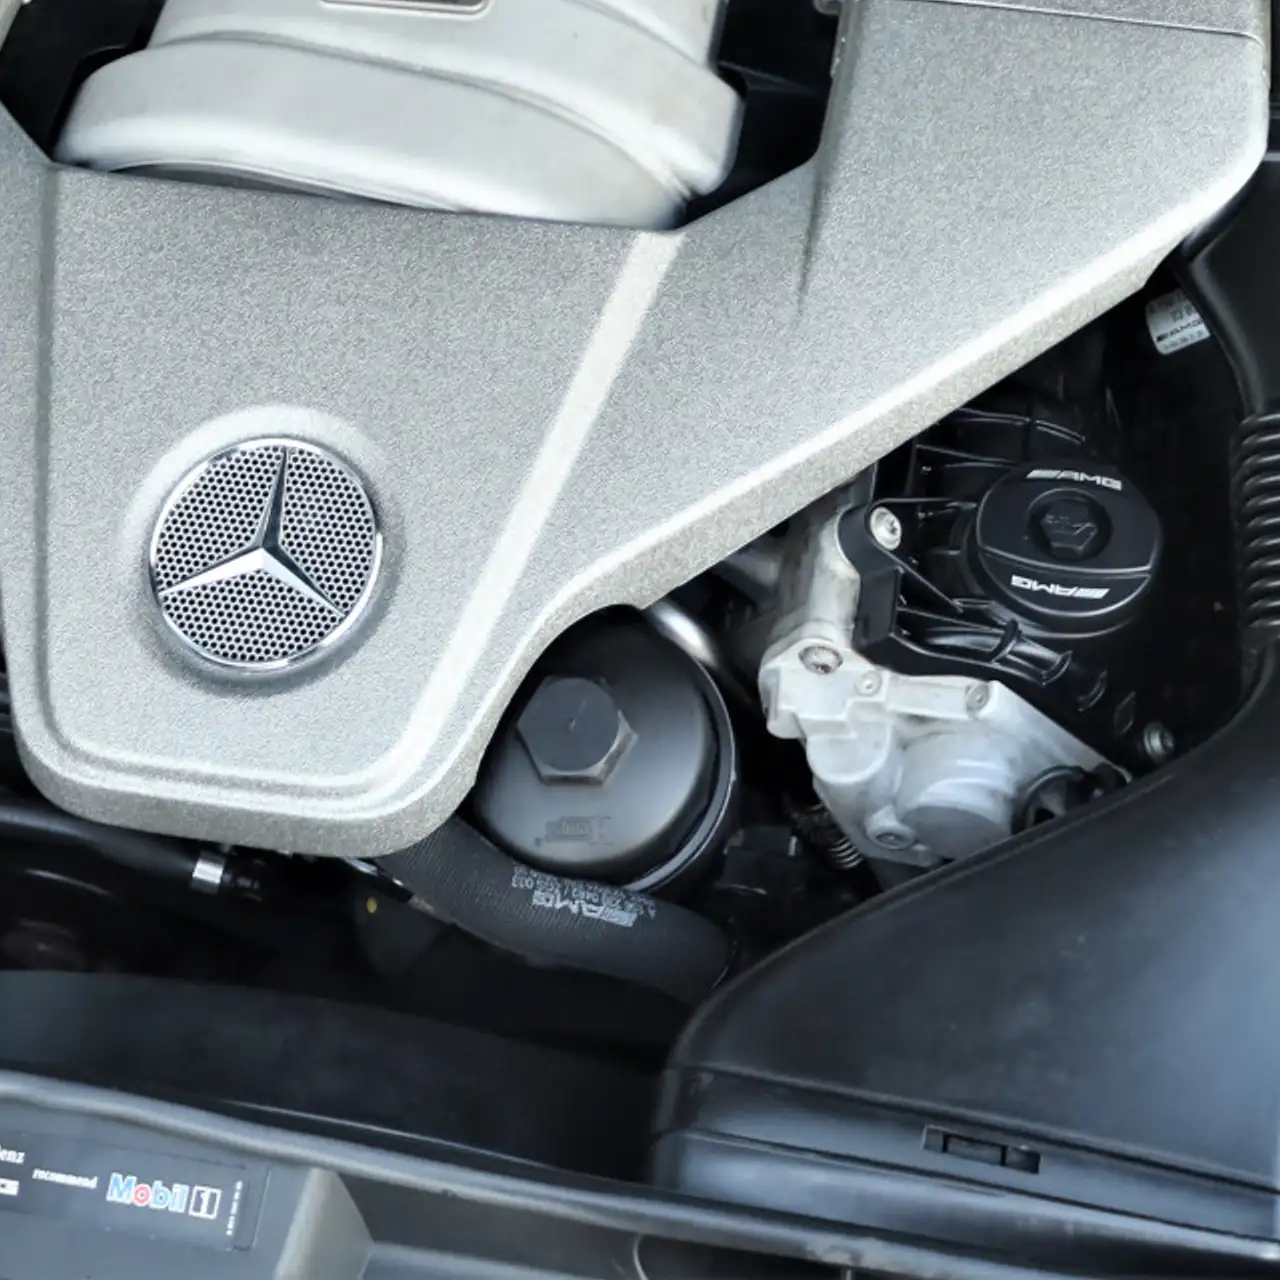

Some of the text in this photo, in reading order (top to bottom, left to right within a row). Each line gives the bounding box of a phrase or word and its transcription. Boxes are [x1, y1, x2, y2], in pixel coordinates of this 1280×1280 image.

[1056, 470, 1122, 491] AMG
[1011, 574, 1079, 597] AMG
[31, 1168, 99, 1190] recommend
[106, 1171, 190, 1213] Mobil
